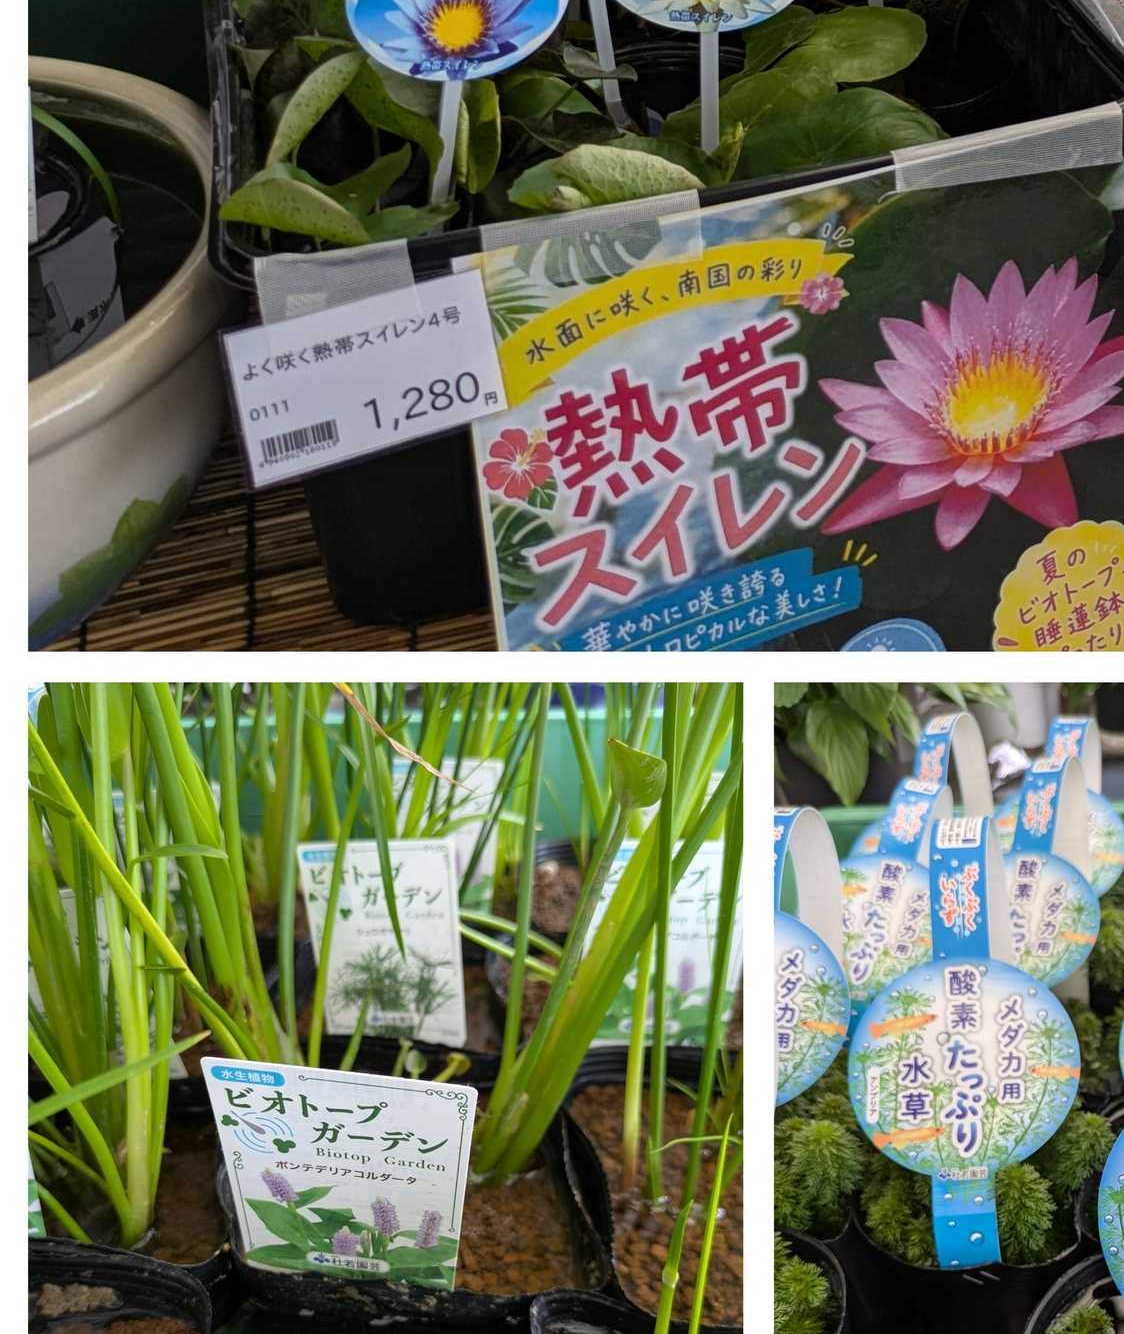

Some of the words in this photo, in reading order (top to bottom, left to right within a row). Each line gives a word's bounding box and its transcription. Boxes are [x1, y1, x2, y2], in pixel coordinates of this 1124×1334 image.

[524, 256, 806, 365] 水面に咲く、南国の彩り
[243, 305, 462, 382] よく咲く熱帯スイレン4号
[250, 399, 290, 422] 0111
[545, 316, 802, 520] 熱帯
[534, 441, 866, 630] スイレン
[1037, 545, 1086, 584] 夏の
[582, 571, 786, 651] 華やかに咲き誇る
[939, 874, 957, 927] いらず
[963, 862, 980, 932] ぶくぶく
[1037, 883, 1067, 956] メダカ用
[221, 1069, 275, 1085] 水生植物
[943, 969, 984, 1154] 酸素たっぷり
[999, 997, 1025, 1101] メダカ用
[224, 1087, 389, 1125] ビオトープ
[868, 1075, 878, 1118] アンブリア
[900, 1056, 931, 1120] 水草
[310, 1121, 449, 1155] ガーデン
[316, 1146, 371, 1165] Biotop
[384, 1156, 446, 1173] Garden
[275, 1160, 417, 1186] ポンテデリアコルダータ
